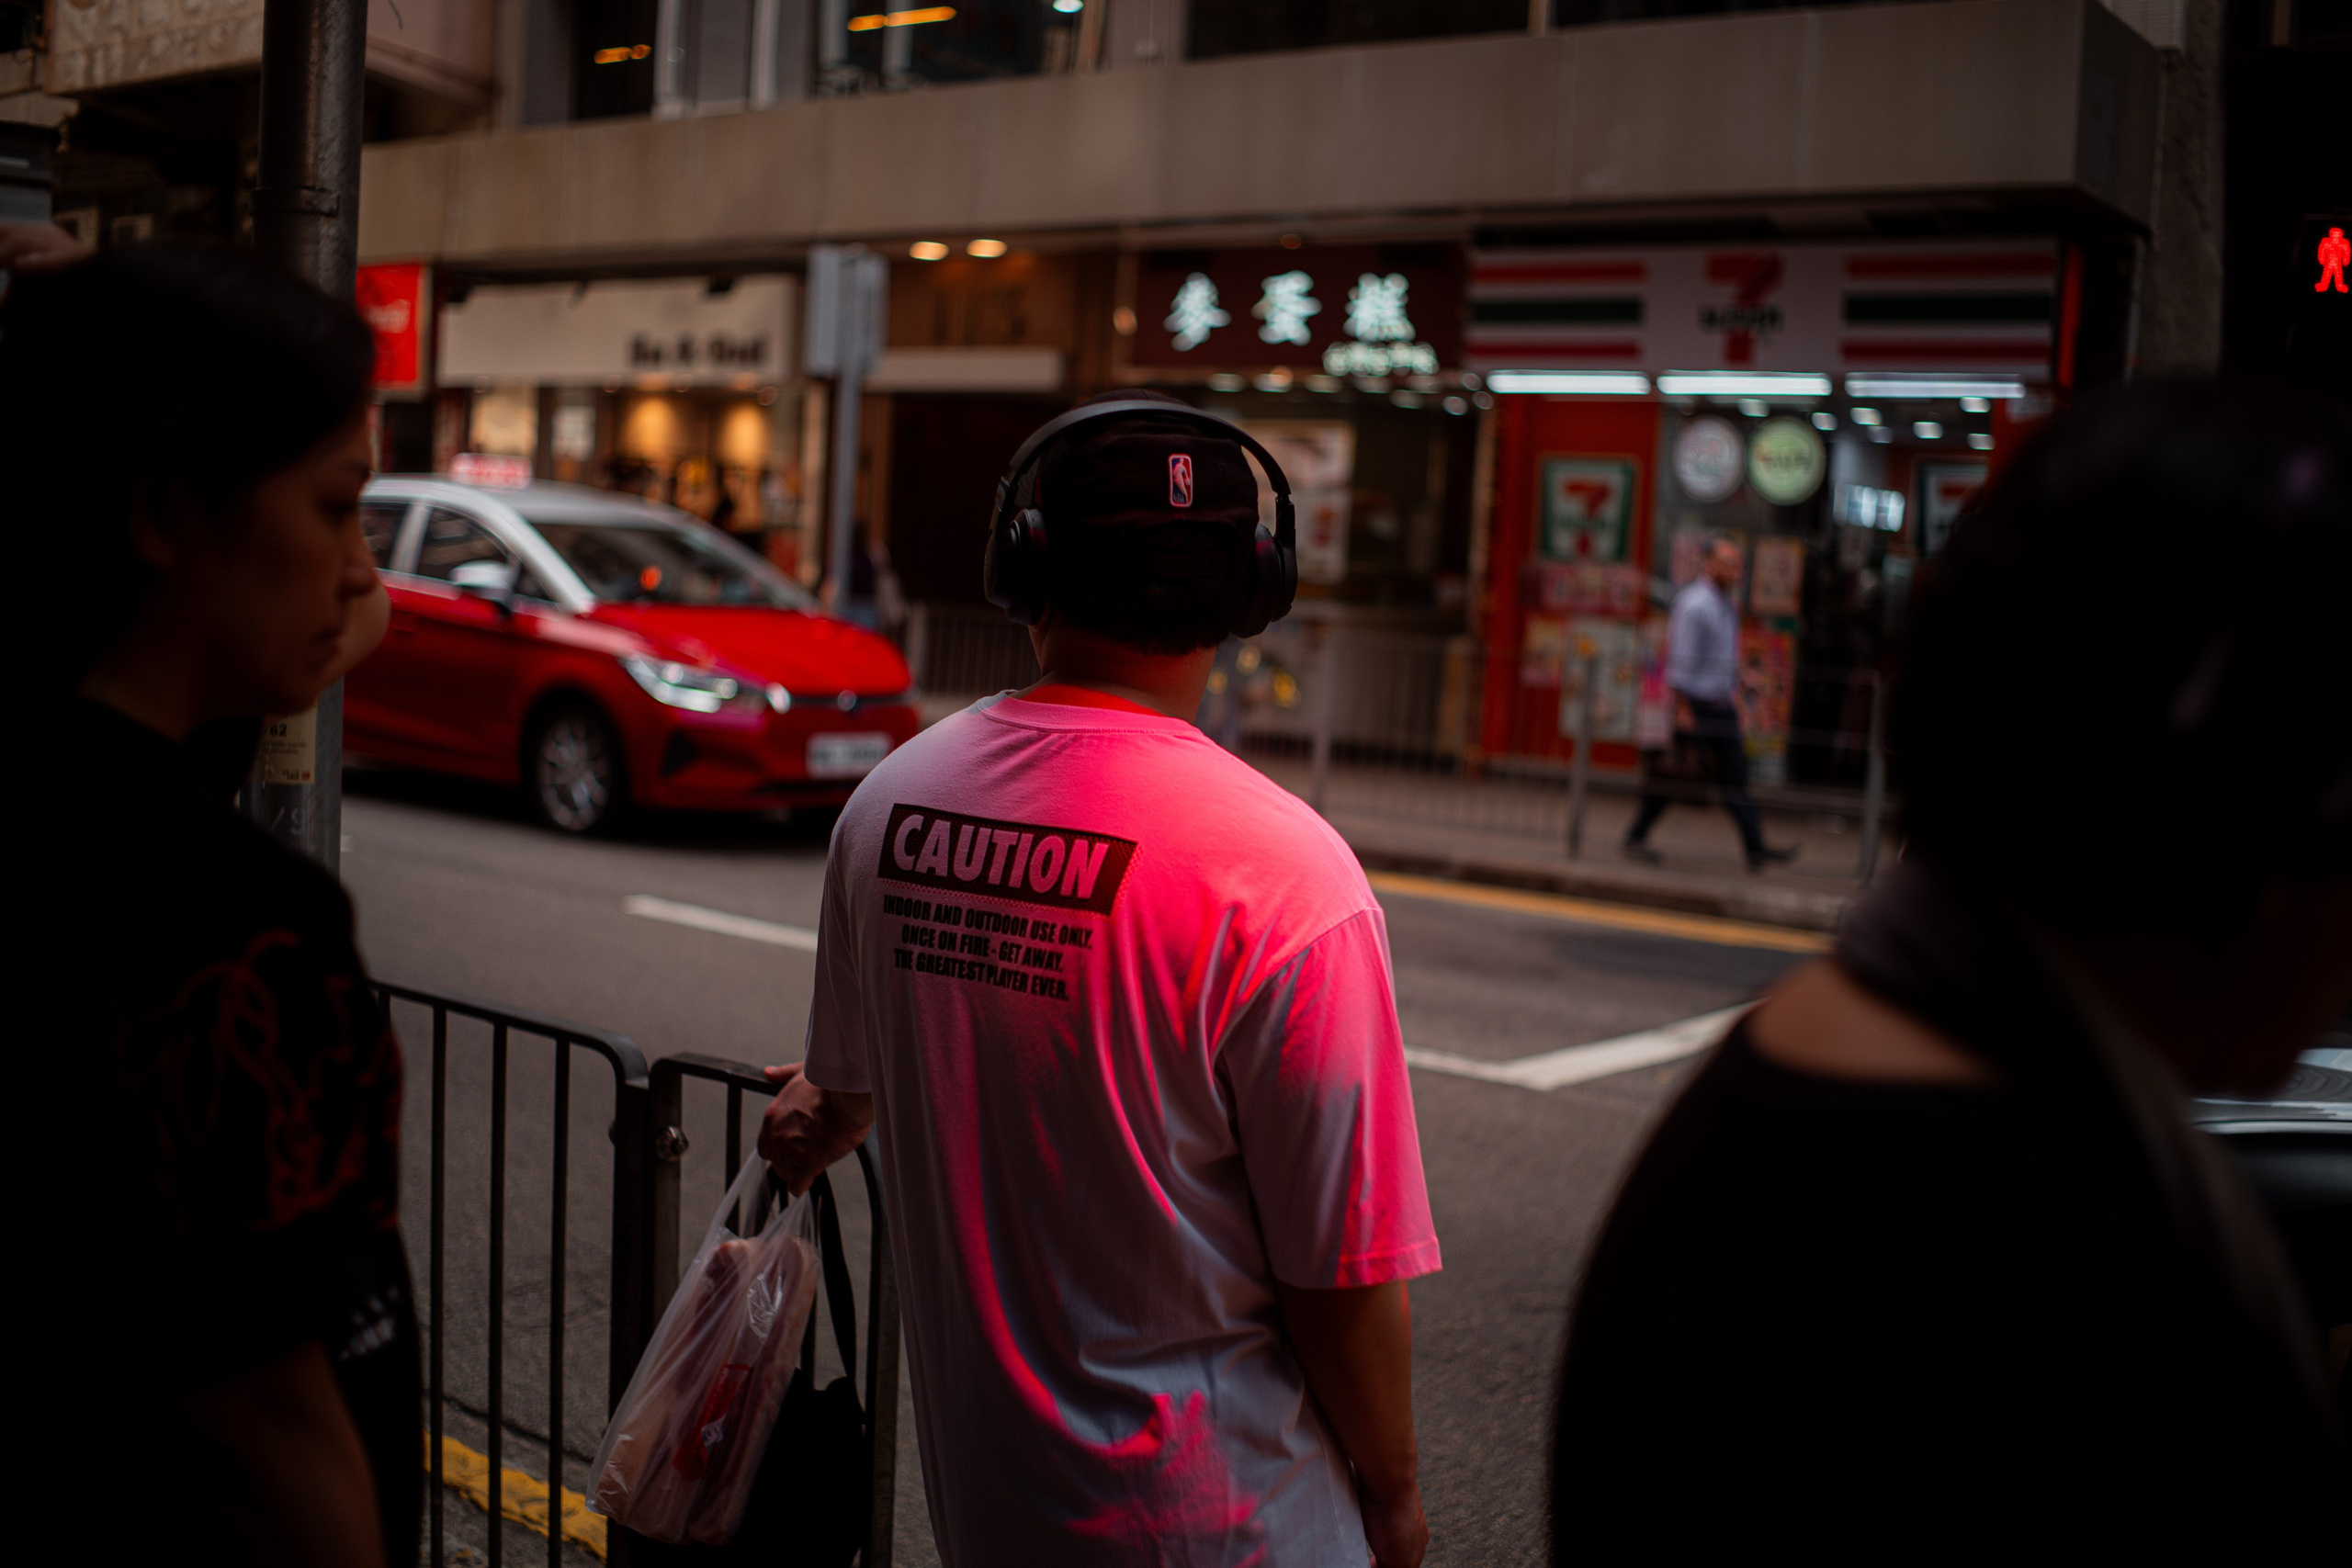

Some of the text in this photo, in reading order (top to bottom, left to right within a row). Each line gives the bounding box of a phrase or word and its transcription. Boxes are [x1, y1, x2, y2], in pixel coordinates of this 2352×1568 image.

[893, 814, 1110, 900] CAUTION
[883, 894, 1092, 951] INDOOR AND OUTDOOR USE ONLY.
[902, 924, 936, 949] ONCE
[938, 931, 958, 952] ON
[959, 934, 989, 958] FIRE
[999, 941, 1022, 964] GET
[1022, 946, 1064, 973] AWAY.
[894, 948, 1069, 1002] THE GREATEST PLAYER EVER.
